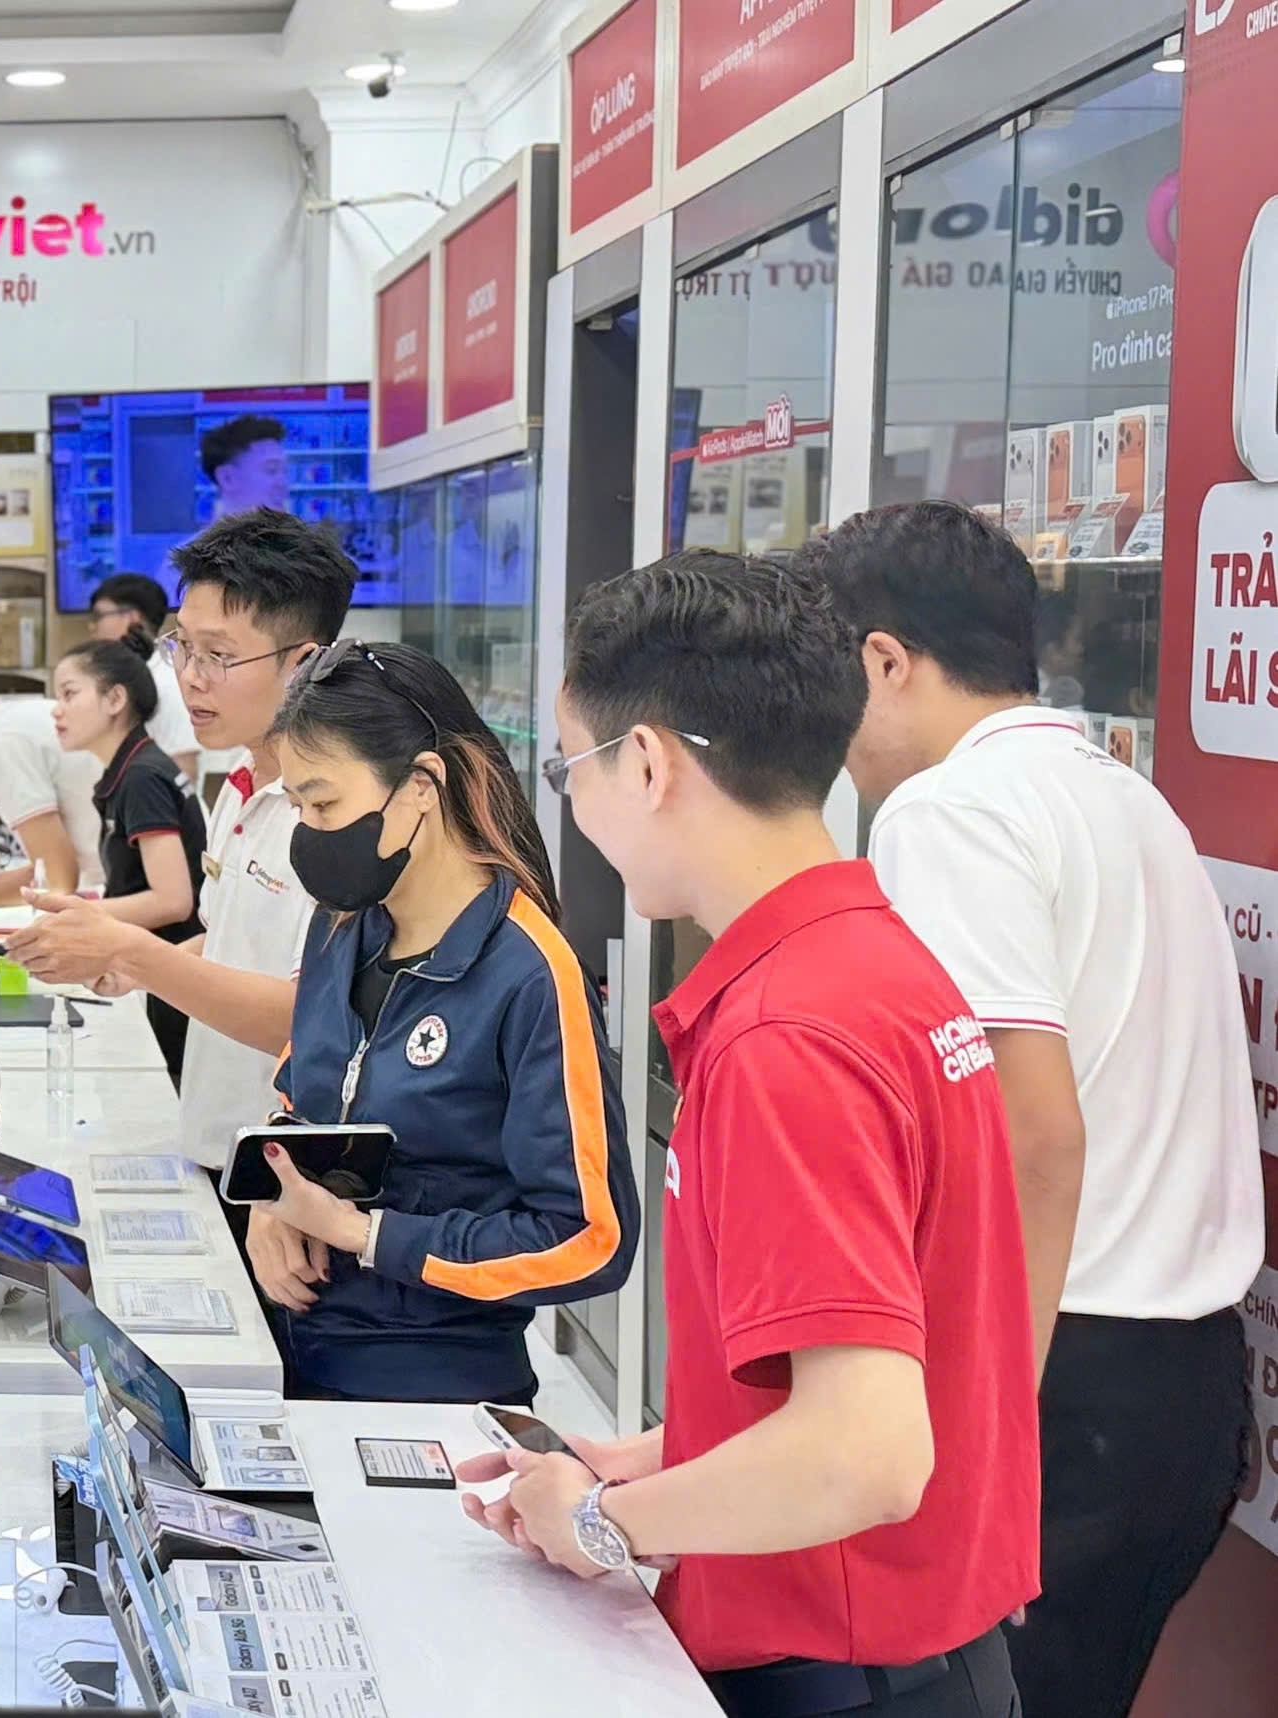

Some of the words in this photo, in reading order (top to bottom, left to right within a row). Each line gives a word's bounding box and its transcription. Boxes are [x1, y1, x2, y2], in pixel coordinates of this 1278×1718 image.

[1113, 296, 1147, 318] iPhone
[1148, 286, 1159, 310] 17
[1092, 340, 1117, 371] Pro
[1120, 329, 1154, 366] đỉnh
[1210, 531, 1278, 608] TRẢ
[1205, 631, 1257, 706] LÃI
